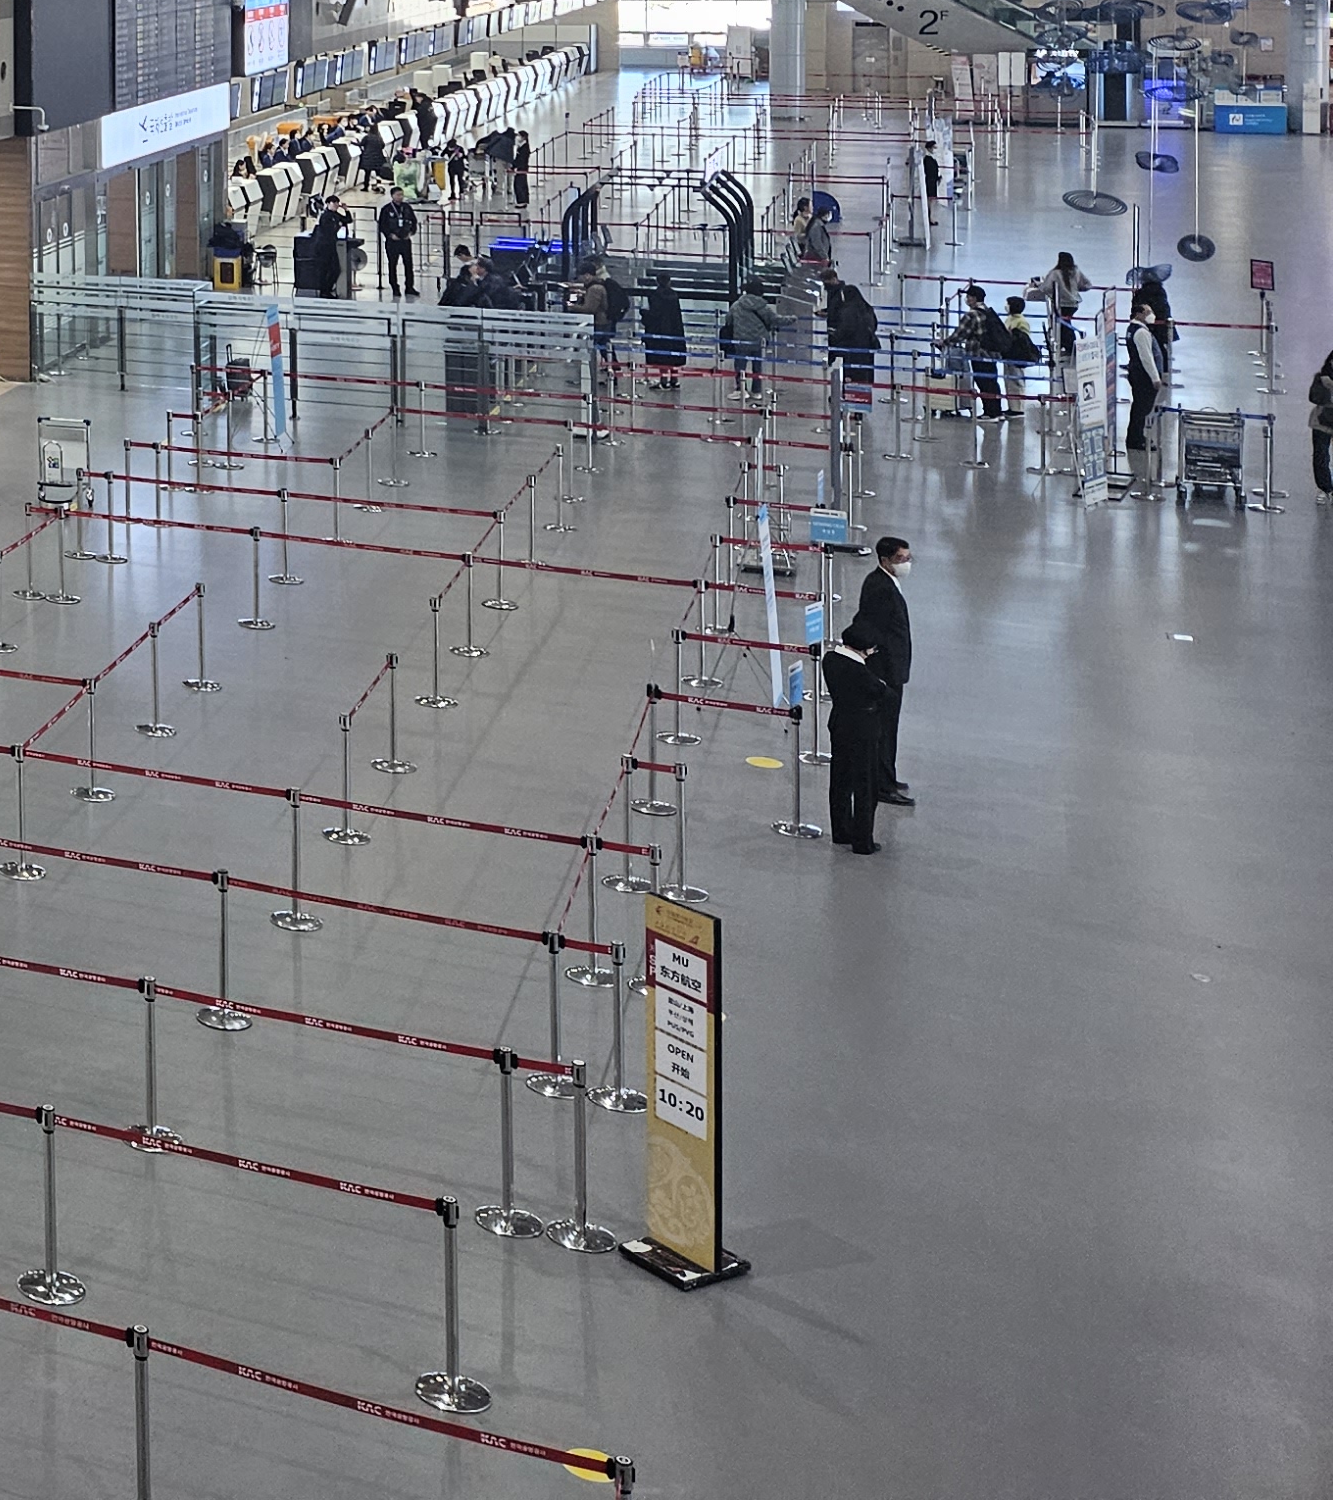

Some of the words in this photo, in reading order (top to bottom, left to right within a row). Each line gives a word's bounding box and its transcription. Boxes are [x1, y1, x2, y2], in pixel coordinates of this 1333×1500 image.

[919, 10, 949, 35] 2F
[672, 953, 690, 968] MU
[659, 965, 702, 993] 东方航空
[667, 1044, 695, 1064] OPEN
[671, 1062, 690, 1080] 开始
[659, 1088, 705, 1122] 10:20
[238, 1365, 262, 1381] KAC
[357, 1399, 381, 1415] KAC
[480, 1432, 506, 1448] KAC
